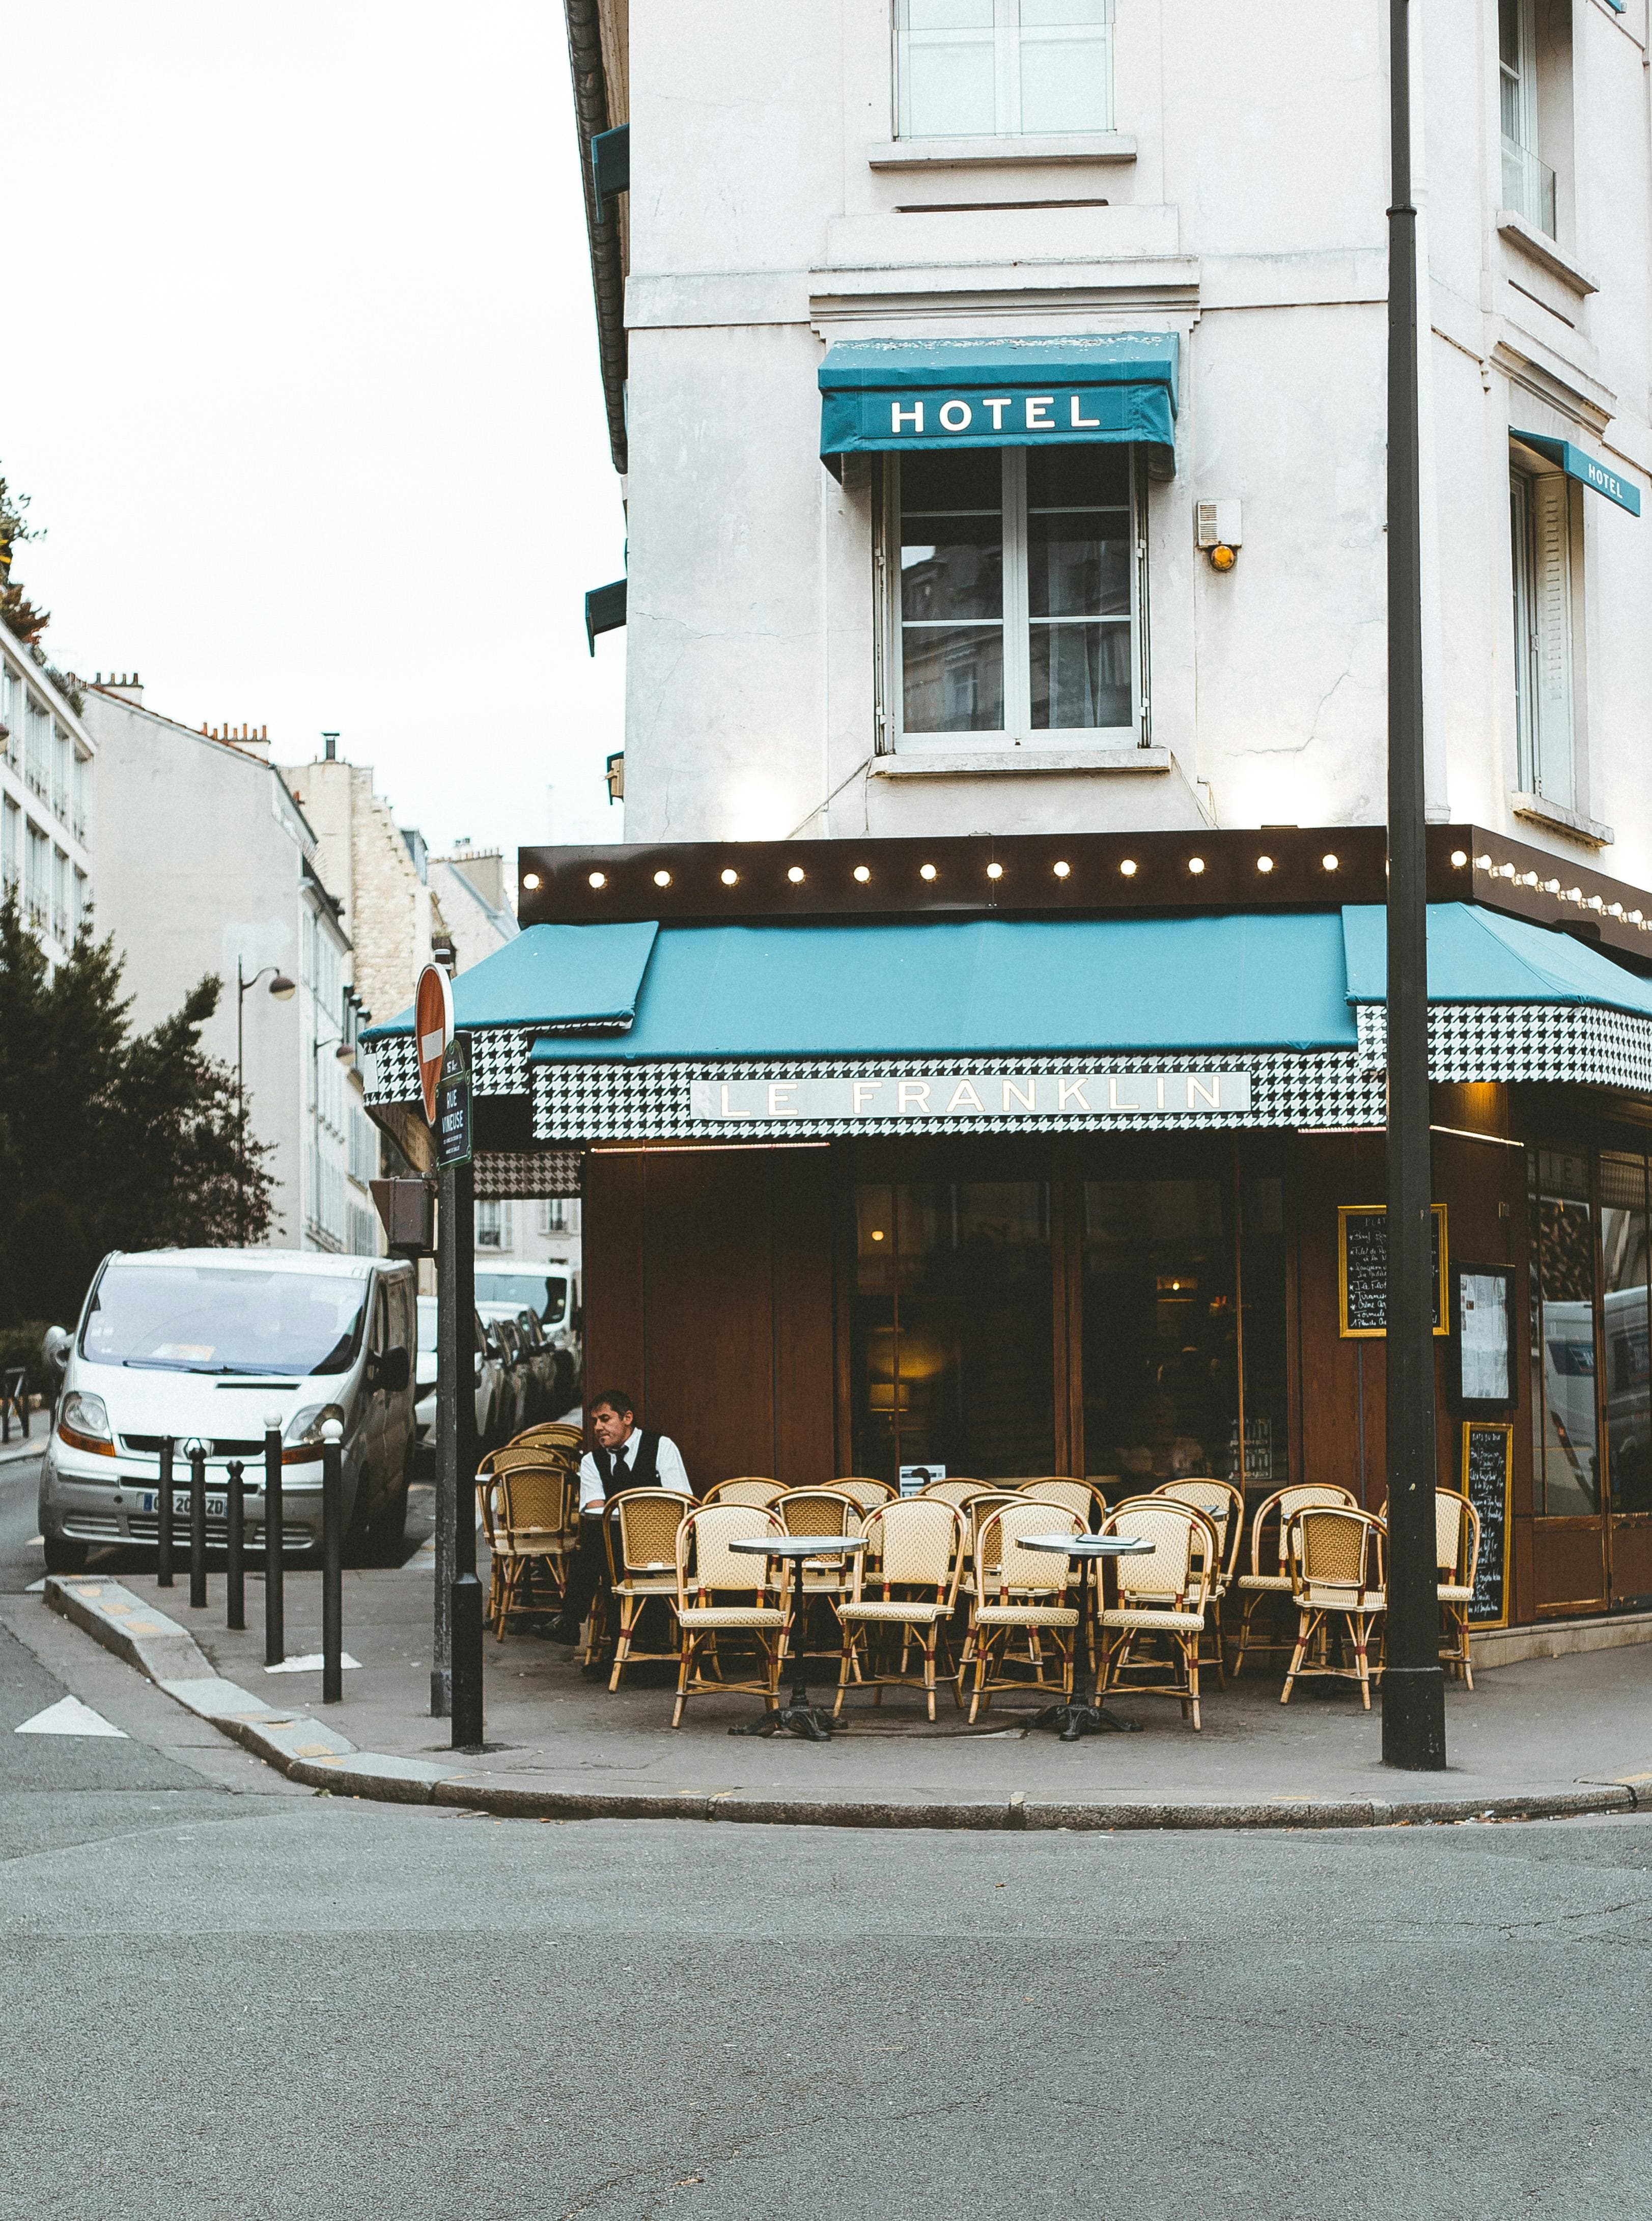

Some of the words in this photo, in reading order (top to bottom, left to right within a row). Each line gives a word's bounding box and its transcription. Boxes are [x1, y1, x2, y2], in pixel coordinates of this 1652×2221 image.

[891, 395, 1101, 433] HOTEL
[1588, 463, 1623, 499] HOTEL
[446, 1089, 457, 1109] RUE
[720, 1083, 799, 1117] LE
[853, 1076, 1221, 1114] FRANKLIN
[442, 1109, 463, 1134] VINEUSE
[1365, 1217, 1386, 1227] PLAT
